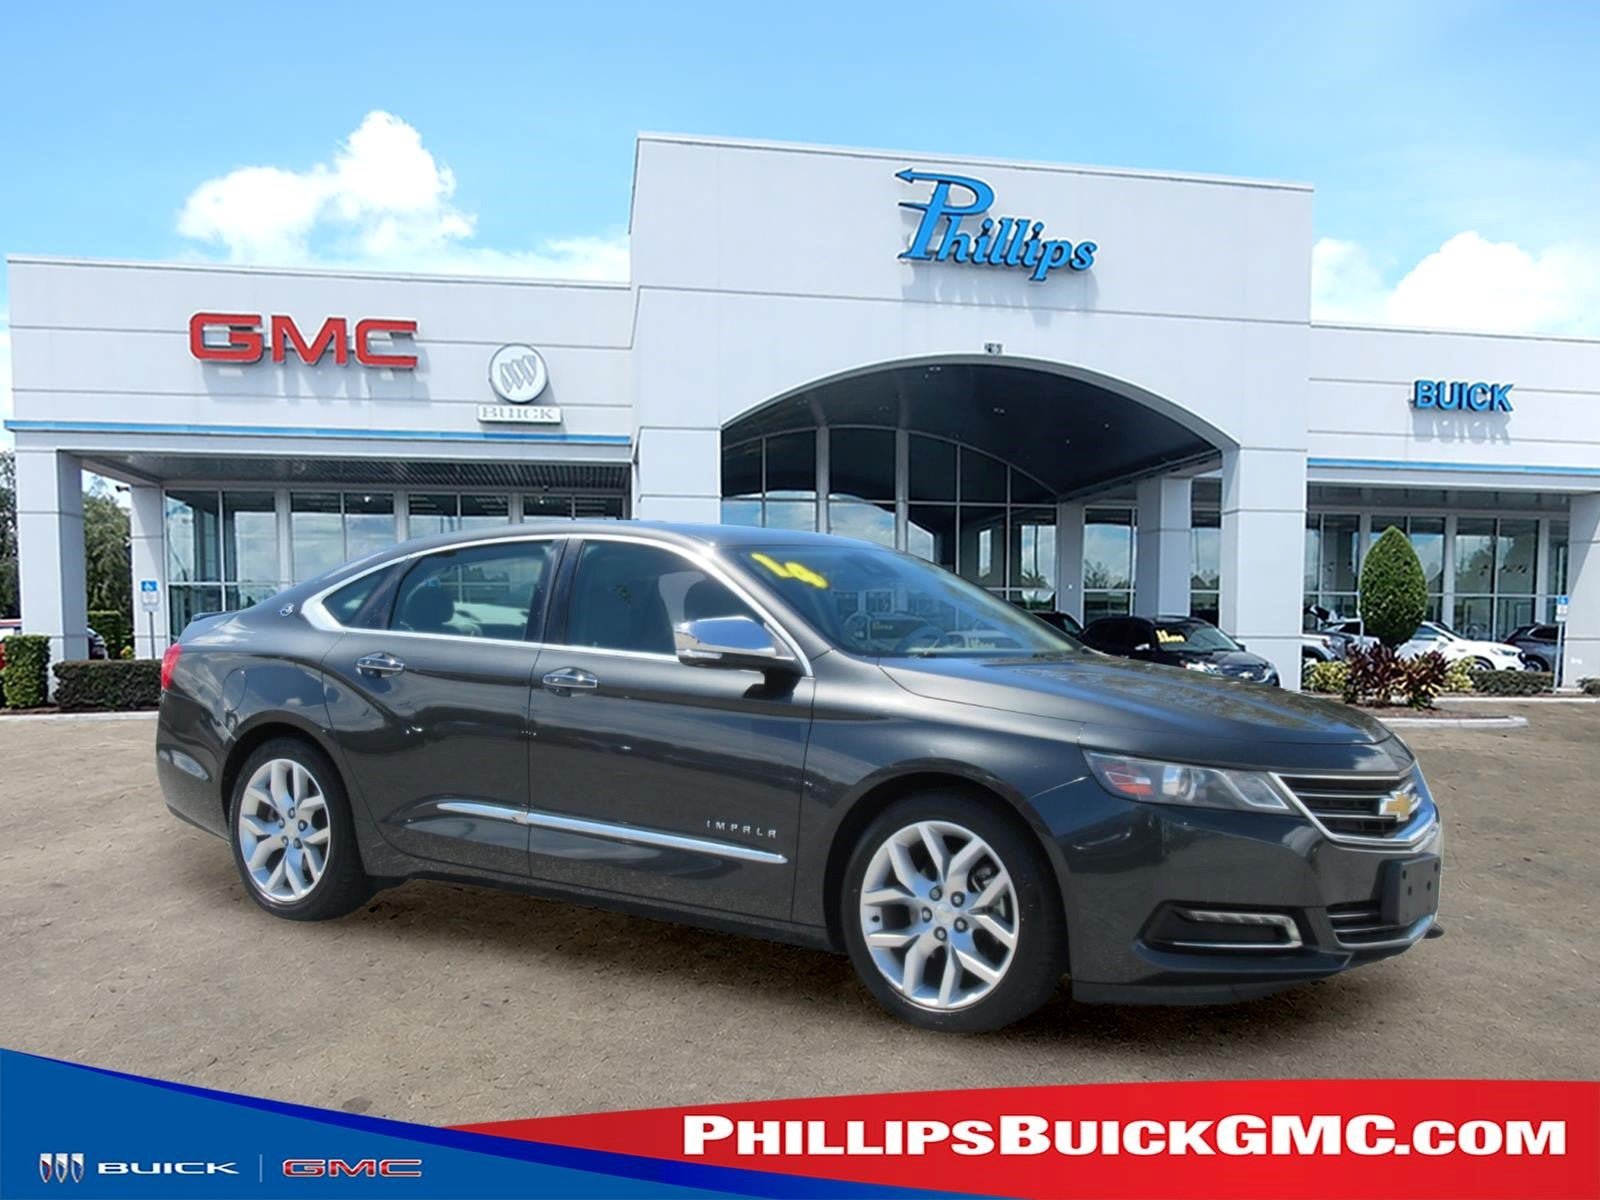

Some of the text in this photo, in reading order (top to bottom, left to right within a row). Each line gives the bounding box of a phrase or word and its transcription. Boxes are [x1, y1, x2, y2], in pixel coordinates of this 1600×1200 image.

[895, 168, 1098, 282] Phillips
[190, 312, 418, 370] GMC
[1414, 379, 1514, 412] BUICK
[482, 407, 554, 419] BUICK
[706, 819, 777, 838] IMPALA
